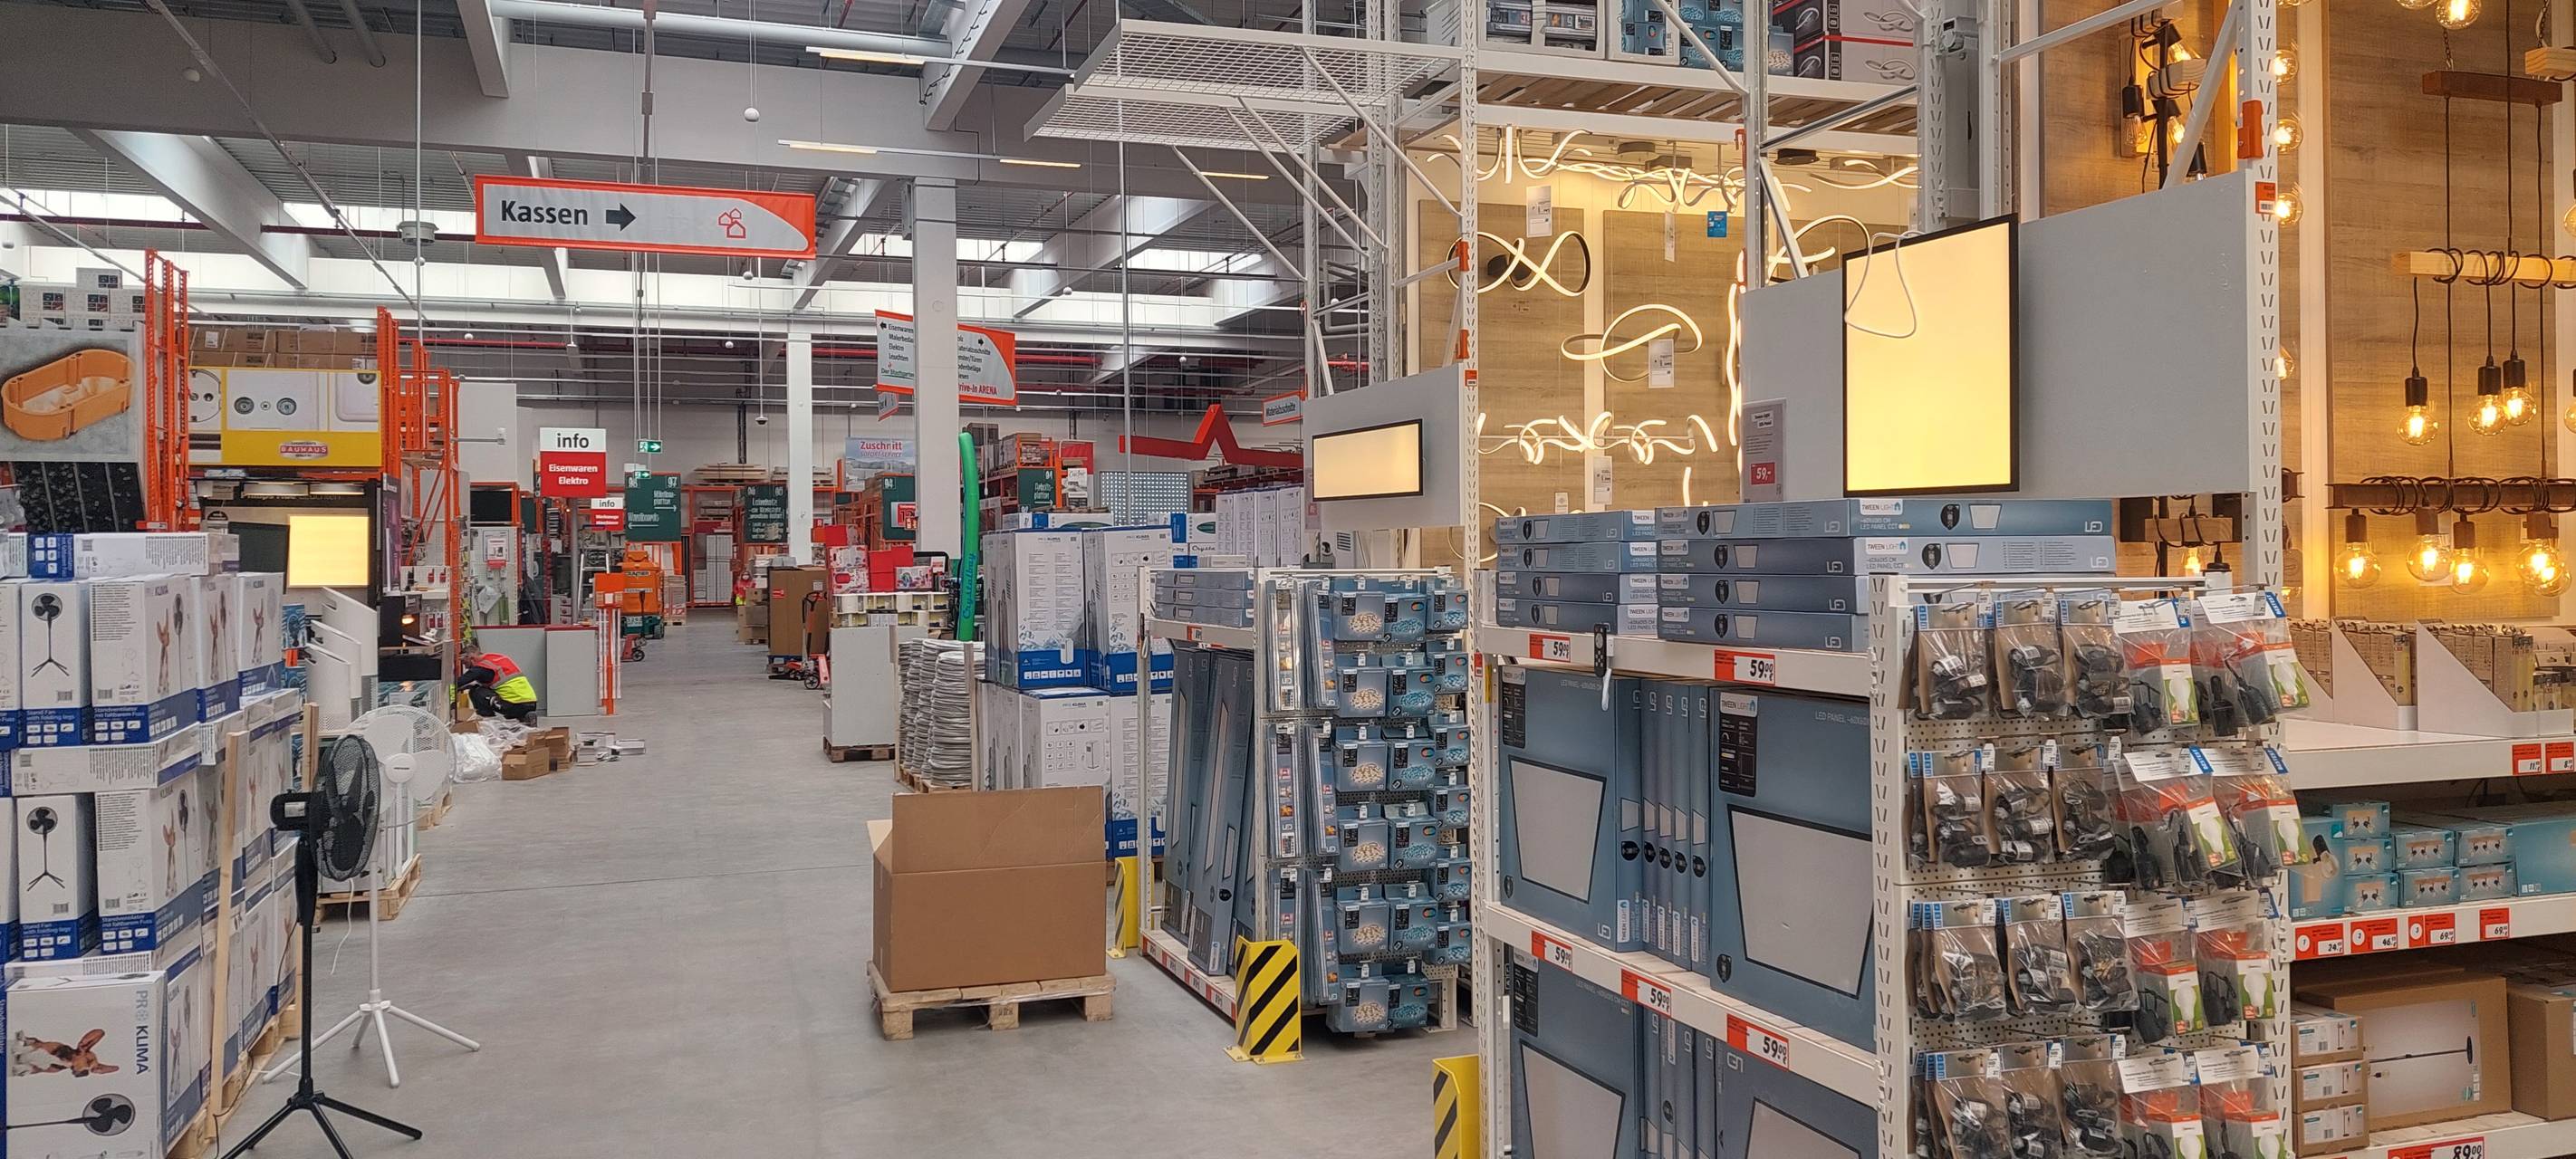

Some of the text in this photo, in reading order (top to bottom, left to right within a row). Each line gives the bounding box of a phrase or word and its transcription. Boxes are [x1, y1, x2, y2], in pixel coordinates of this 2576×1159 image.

[501, 200, 588, 225] Kassen
[889, 323, 914, 334] Eisenwaren
[889, 333, 914, 343] Malerbeda
[889, 342, 905, 351] Elektro
[889, 352, 909, 363] Leuchten
[958, 382, 997, 395] rive-In ARENA
[557, 433, 590, 448] info
[860, 441, 903, 451] Zuschnitt
[548, 464, 598, 473] Eisenwaren
[1755, 467, 1772, 482] 59,-
[558, 476, 589, 485] Elektro
[668, 476, 678, 488] 97
[599, 500, 616, 508] info
[962, 552, 977, 619] Crystalbay
[1722, 699, 1736, 709] TWEEN
[1815, 710, 1846, 723] LED PANEL
[102, 915, 145, 923] Standventilator
[136, 991, 149, 1076] PRO KLIMA
